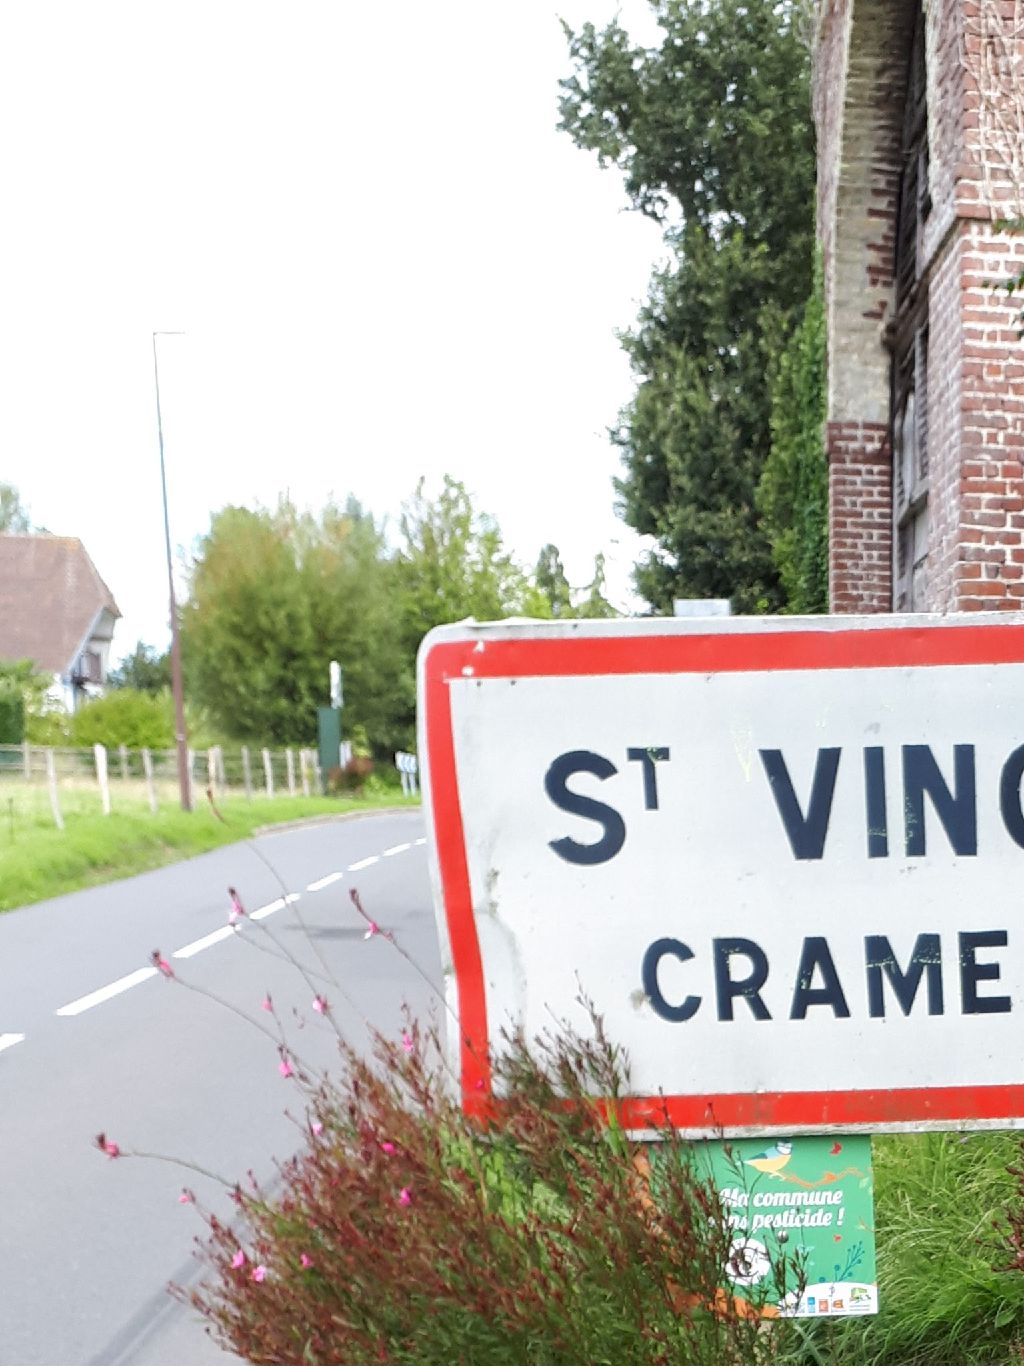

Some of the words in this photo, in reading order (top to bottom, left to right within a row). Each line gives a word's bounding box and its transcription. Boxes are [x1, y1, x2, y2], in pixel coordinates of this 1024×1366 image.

[720, 1188, 750, 1207] Ma
[752, 1190, 843, 1207] commune
[752, 1208, 833, 1233] pesticide
